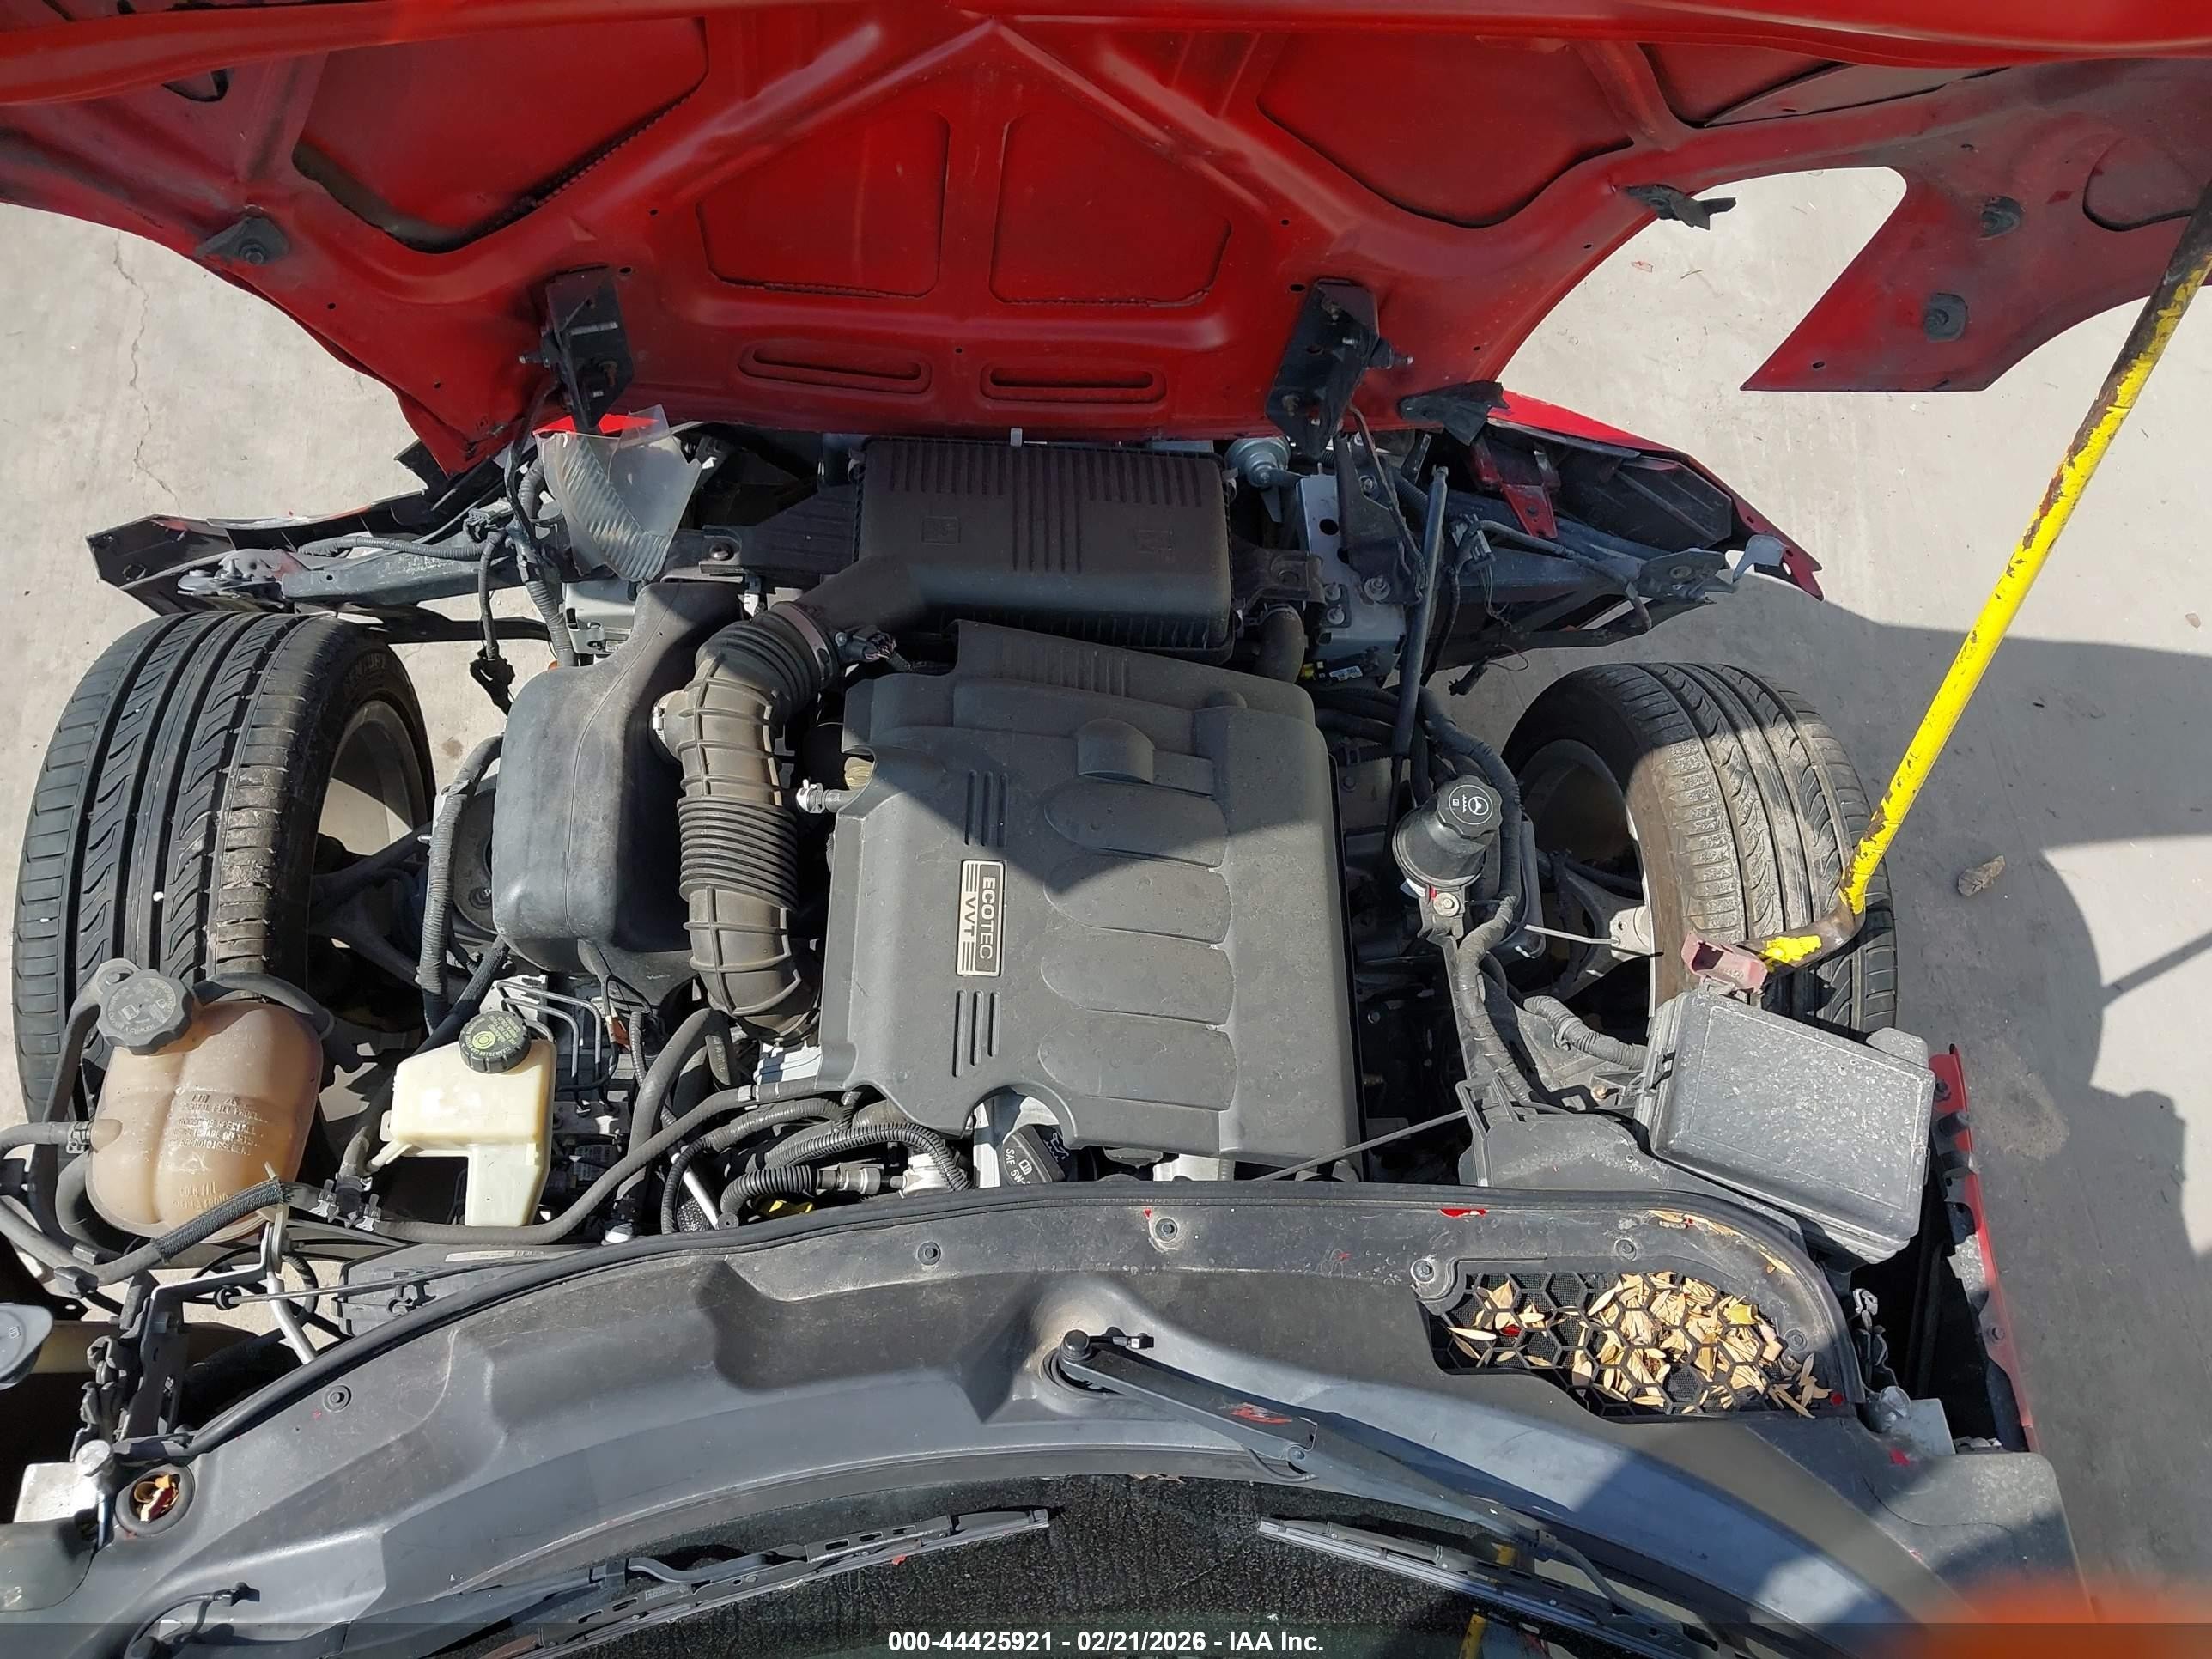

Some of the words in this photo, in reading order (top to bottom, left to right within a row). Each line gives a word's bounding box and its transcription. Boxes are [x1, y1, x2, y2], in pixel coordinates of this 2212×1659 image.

[963, 896, 976, 937] VVT
[979, 876, 996, 960] ECOTEC
[1006, 1148, 1016, 1165] SAE
